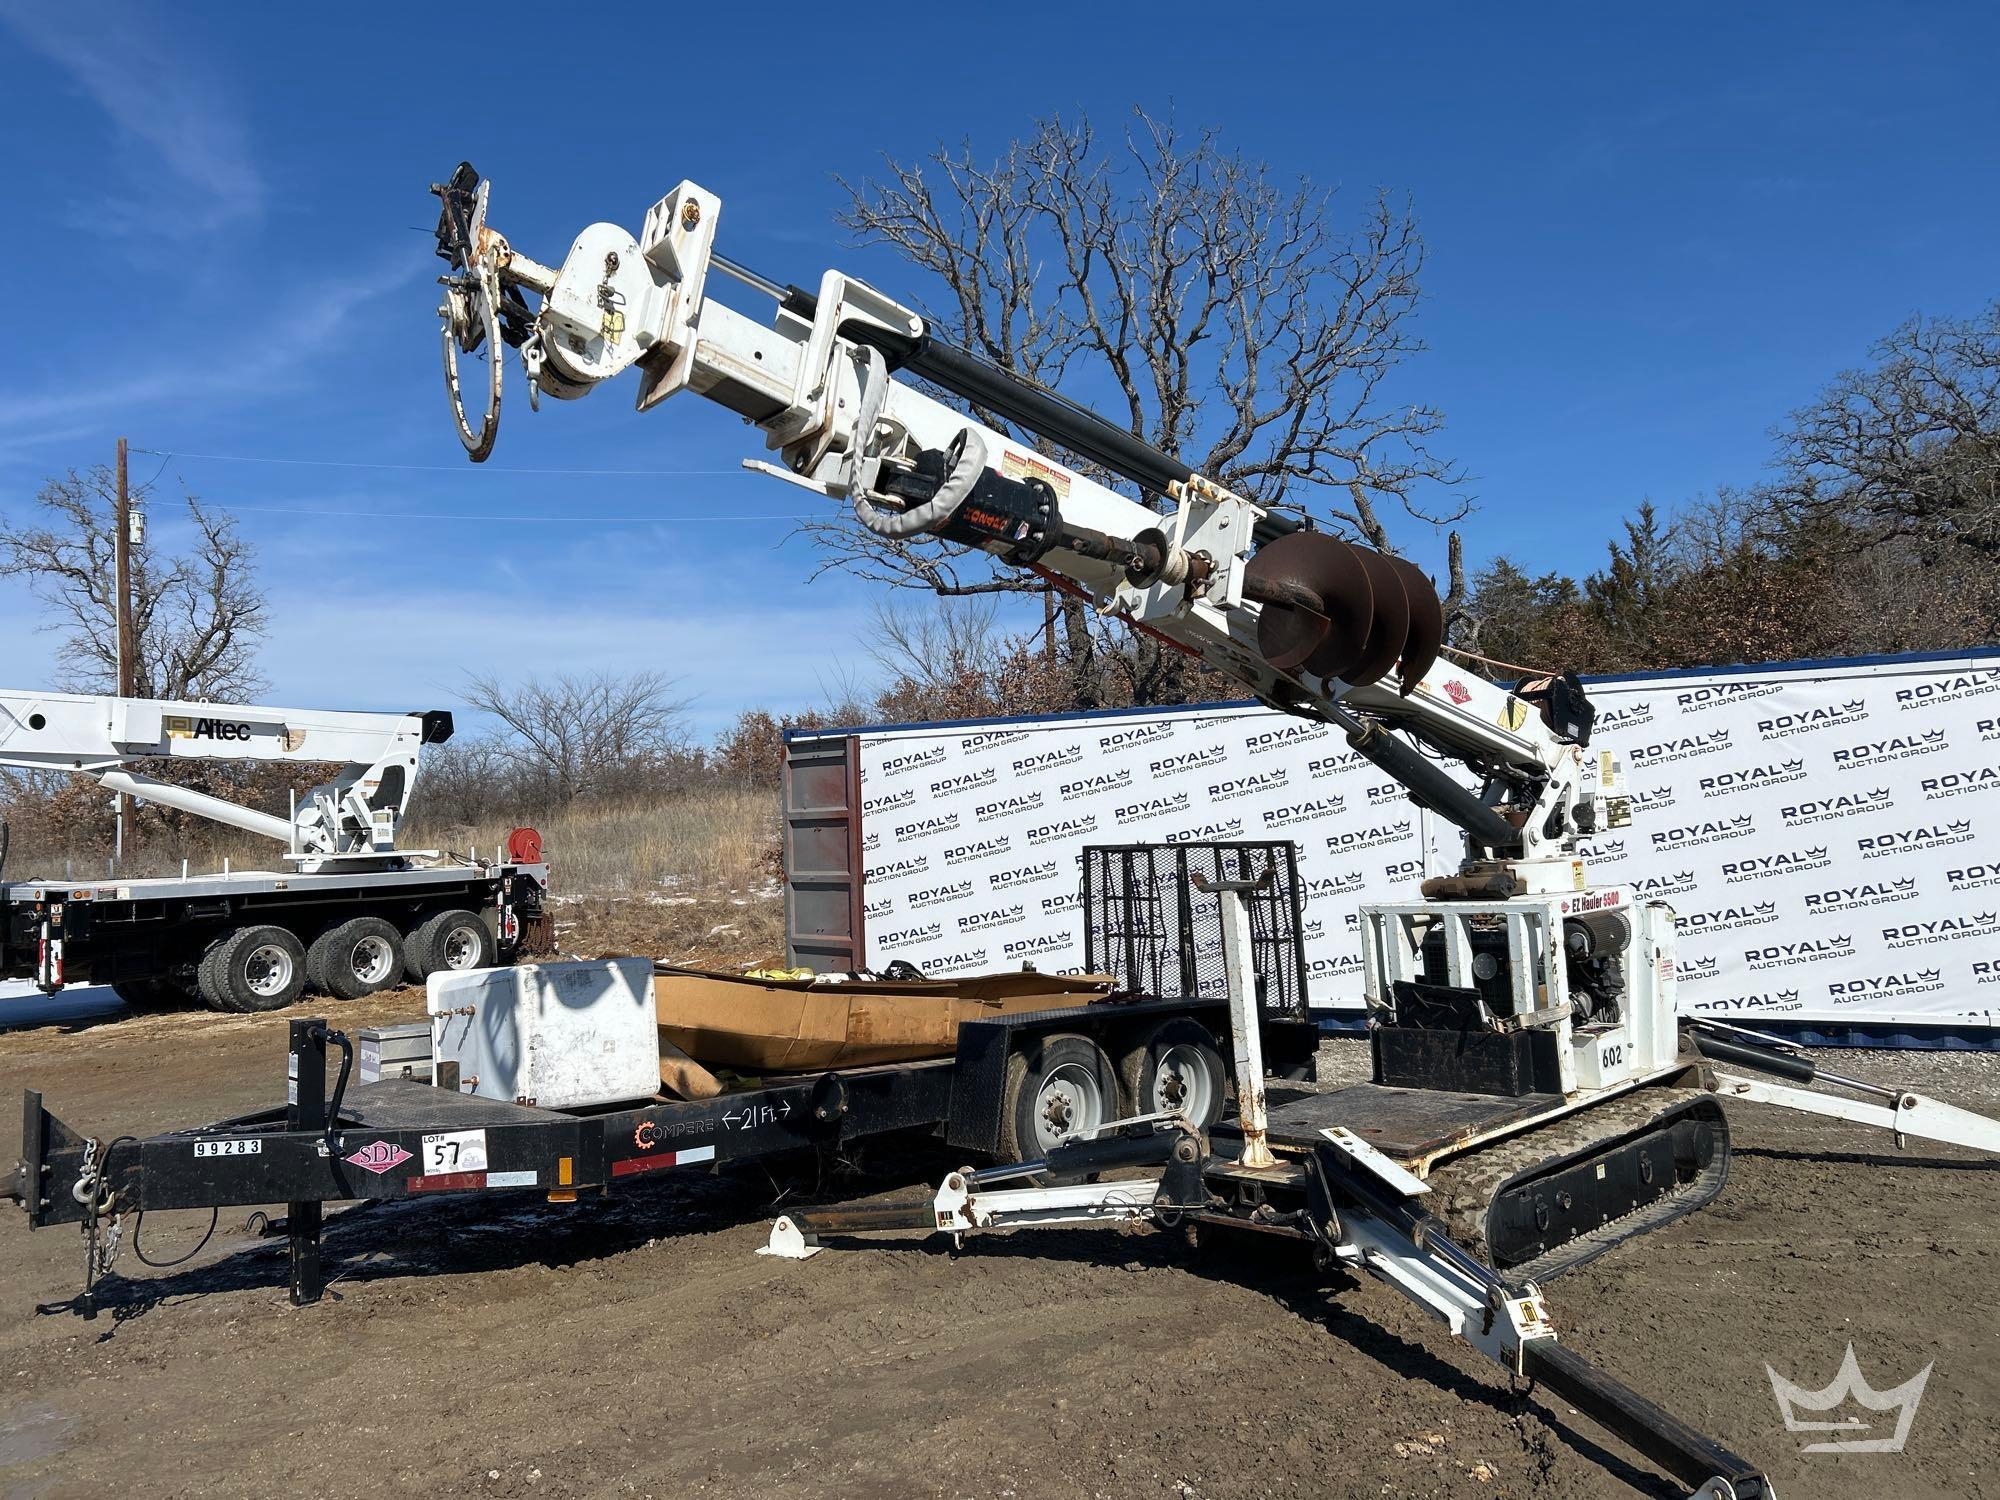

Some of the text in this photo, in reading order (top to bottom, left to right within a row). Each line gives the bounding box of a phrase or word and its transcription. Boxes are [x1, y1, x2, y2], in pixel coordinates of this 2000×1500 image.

[1896, 675, 1987, 702] ROYAL
[1682, 686, 1783, 714] AUCTION GROUP
[1901, 692, 1962, 711] AUCTION
[193, 718, 250, 741] Altec
[1195, 716, 1236, 730] AUCTION
[1612, 716, 1653, 730] GROUP
[1758, 707, 1843, 732] ROYAL
[1762, 713, 1869, 741] AUCTION GROUP
[965, 734, 1029, 755] AUCTION GROUP
[1100, 726, 1157, 747] ROYAL
[1103, 732, 1174, 754] AUCTION GROUP
[1246, 726, 1309, 748] ROYAL
[1249, 731, 1328, 755] AUCTION GROUP
[1630, 736, 1708, 760] ROYAL
[1634, 743, 1732, 768] AUCTION GROUP
[1833, 736, 1922, 762] ROYAL
[1838, 743, 1949, 771] AUCTION GROUP
[883, 752, 934, 770] ROYAL
[885, 757, 946, 777] AUCTION GROUP
[1013, 750, 1066, 770] ROYAL
[1016, 756, 1083, 777] AUCTION GROUP
[1150, 751, 1209, 772] ROYAL
[1153, 756, 1227, 779] AUCTION GROUP
[1308, 752, 1364, 771] ROYA
[1312, 764, 1356, 779] AUCTION
[1700, 766, 1782, 790] ROYAL
[1921, 766, 2000, 791] ROYA
[931, 773, 982, 792] ROYAL
[933, 778, 997, 798] AUCTION GROUP
[1060, 774, 1116, 794] ROYAL
[1063, 780, 1132, 801] AUCTION GROUP
[1208, 774, 1270, 795] ROYAL
[1212, 780, 1288, 802] AUCTION GROUP
[1367, 782, 1406, 798] ROY
[1704, 773, 1807, 798] AUCTION GROUP
[1926, 783, 1988, 800] AUCTION
[864, 794, 901, 810] OYAL
[889, 800, 916, 811] GROUP
[976, 797, 1028, 816] ROYAL
[978, 802, 1044, 822] AUCTION GROUP
[1115, 798, 1172, 818] ROYAL
[1263, 801, 1327, 822] ROYAL
[1634, 800, 1676, 813] GROUP
[1781, 794, 1868, 818] ROYAL
[1118, 804, 1190, 825] AUCTION GROUP
[1266, 807, 1346, 829] AUCTION GROUP
[1786, 802, 1894, 827] AUCTION GROUP
[895, 818, 945, 836] ROYAL
[898, 823, 960, 842] AUCTION GROUP
[1027, 820, 1081, 839] ROYAL
[1030, 826, 1098, 846] AUCTION GROUP
[1166, 824, 1226, 844] ROYAL
[1211, 830, 1244, 842] GROUP
[1326, 826, 1393, 847] ROYAL
[1651, 821, 1733, 844] ROYAL
[1330, 833, 1413, 855] AUCTION GROUP
[1656, 829, 1755, 852] AUCTION GROUP
[1858, 826, 1948, 850] ROYAL
[1863, 834, 1975, 859] AUCTION GROUP
[944, 841, 996, 859] ROYAL
[947, 846, 1011, 866] AUCTION GROUP
[1587, 853, 1628, 866] GROUP
[866, 860, 914, 878] ROYAL
[1722, 852, 1806, 875] ROYAL
[1727, 860, 1831, 884] AUCTION GROUP
[1947, 862, 2000, 882] ROY
[868, 866, 929, 885] AUCTION GROUP
[990, 866, 1042, 884] ROYAL
[992, 872, 1058, 890] AUCTION GROUP
[1308, 876, 1346, 891] YAL
[1629, 877, 1674, 892] YAL
[908, 885, 961, 902] ROYAL
[911, 891, 974, 909] AUCTION GROUP
[1330, 884, 1365, 896] GROUP
[1655, 884, 1697, 896] GROUP
[1805, 884, 1892, 906] ROYAL
[1572, 898, 1580, 913] EZ
[1582, 895, 1602, 911] Hauler
[1603, 891, 1619, 907] 5500
[1810, 892, 1919, 915] AUCTION GROUP
[867, 910, 894, 920] GROUP
[958, 909, 1010, 927] ROYAL
[961, 914, 1025, 934] AUCTION GROUP
[1674, 907, 1754, 929] ROYAL
[878, 928, 928, 944] ROYAL
[1678, 915, 1779, 937] AUCTION GROUP
[1882, 918, 1973, 940] ROYAL
[881, 934, 942, 951] AUCTION GROUP
[1004, 936, 1059, 953] ROYAL
[1888, 926, 2000, 949] AUCTION GROUP
[1007, 942, 1073, 960] AUCTION GROUP
[1745, 940, 1830, 962] ROYAL
[1750, 949, 1855, 970] AUCTION GROUP
[922, 953, 973, 970] ROYAL
[925, 960, 988, 976] AUCTION GROUP
[1676, 970, 1720, 982] GROUP
[1829, 974, 1918, 995] ROYAL
[1834, 983, 1944, 1004] AUCTION GROUP
[1602, 1045, 1622, 1068] 602
[741, 1106, 757, 1130] 21
[424, 1135, 445, 1143] LOT#
[642, 1118, 714, 1140] COMPERE
[197, 1140, 260, 1156] 99283
[360, 1145, 400, 1163] SDP
[435, 1142, 460, 1165] 57
